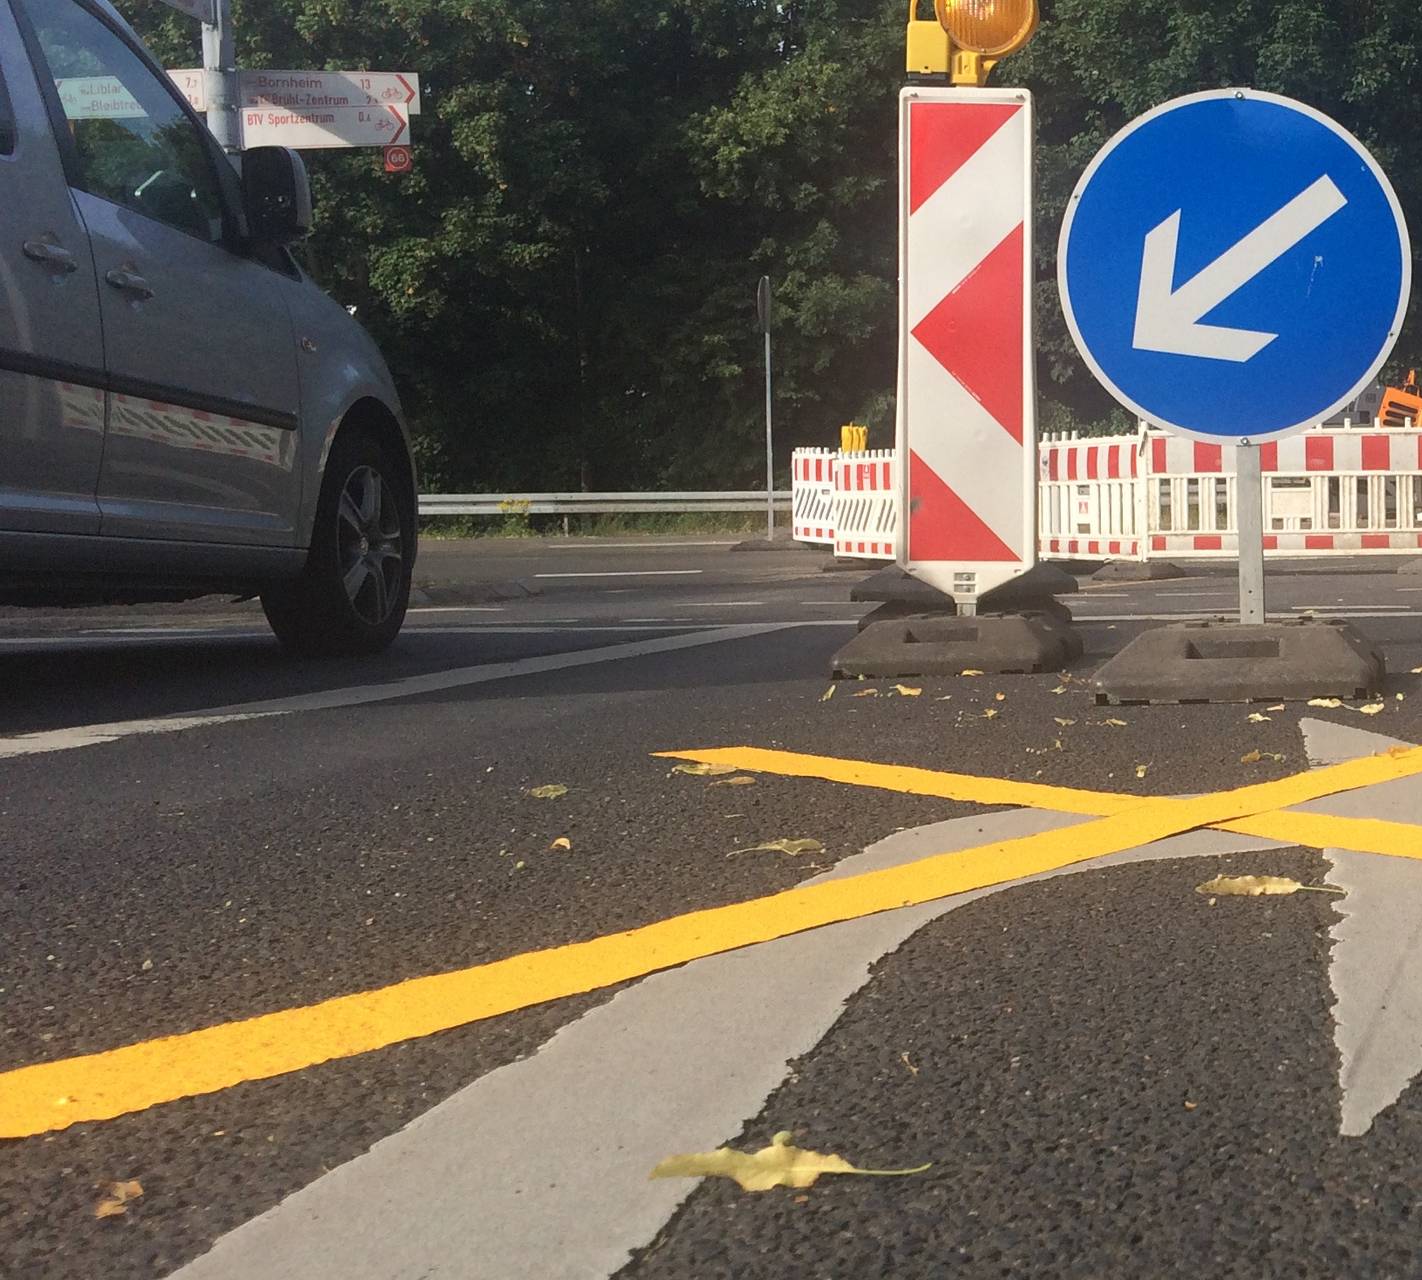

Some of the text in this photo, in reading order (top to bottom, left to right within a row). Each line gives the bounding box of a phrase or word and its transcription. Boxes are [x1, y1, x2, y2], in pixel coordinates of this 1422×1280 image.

[257, 76, 371, 89] Bornheim 13
[247, 114, 263, 126] BTV
[268, 113, 335, 126] Sportzentrum
